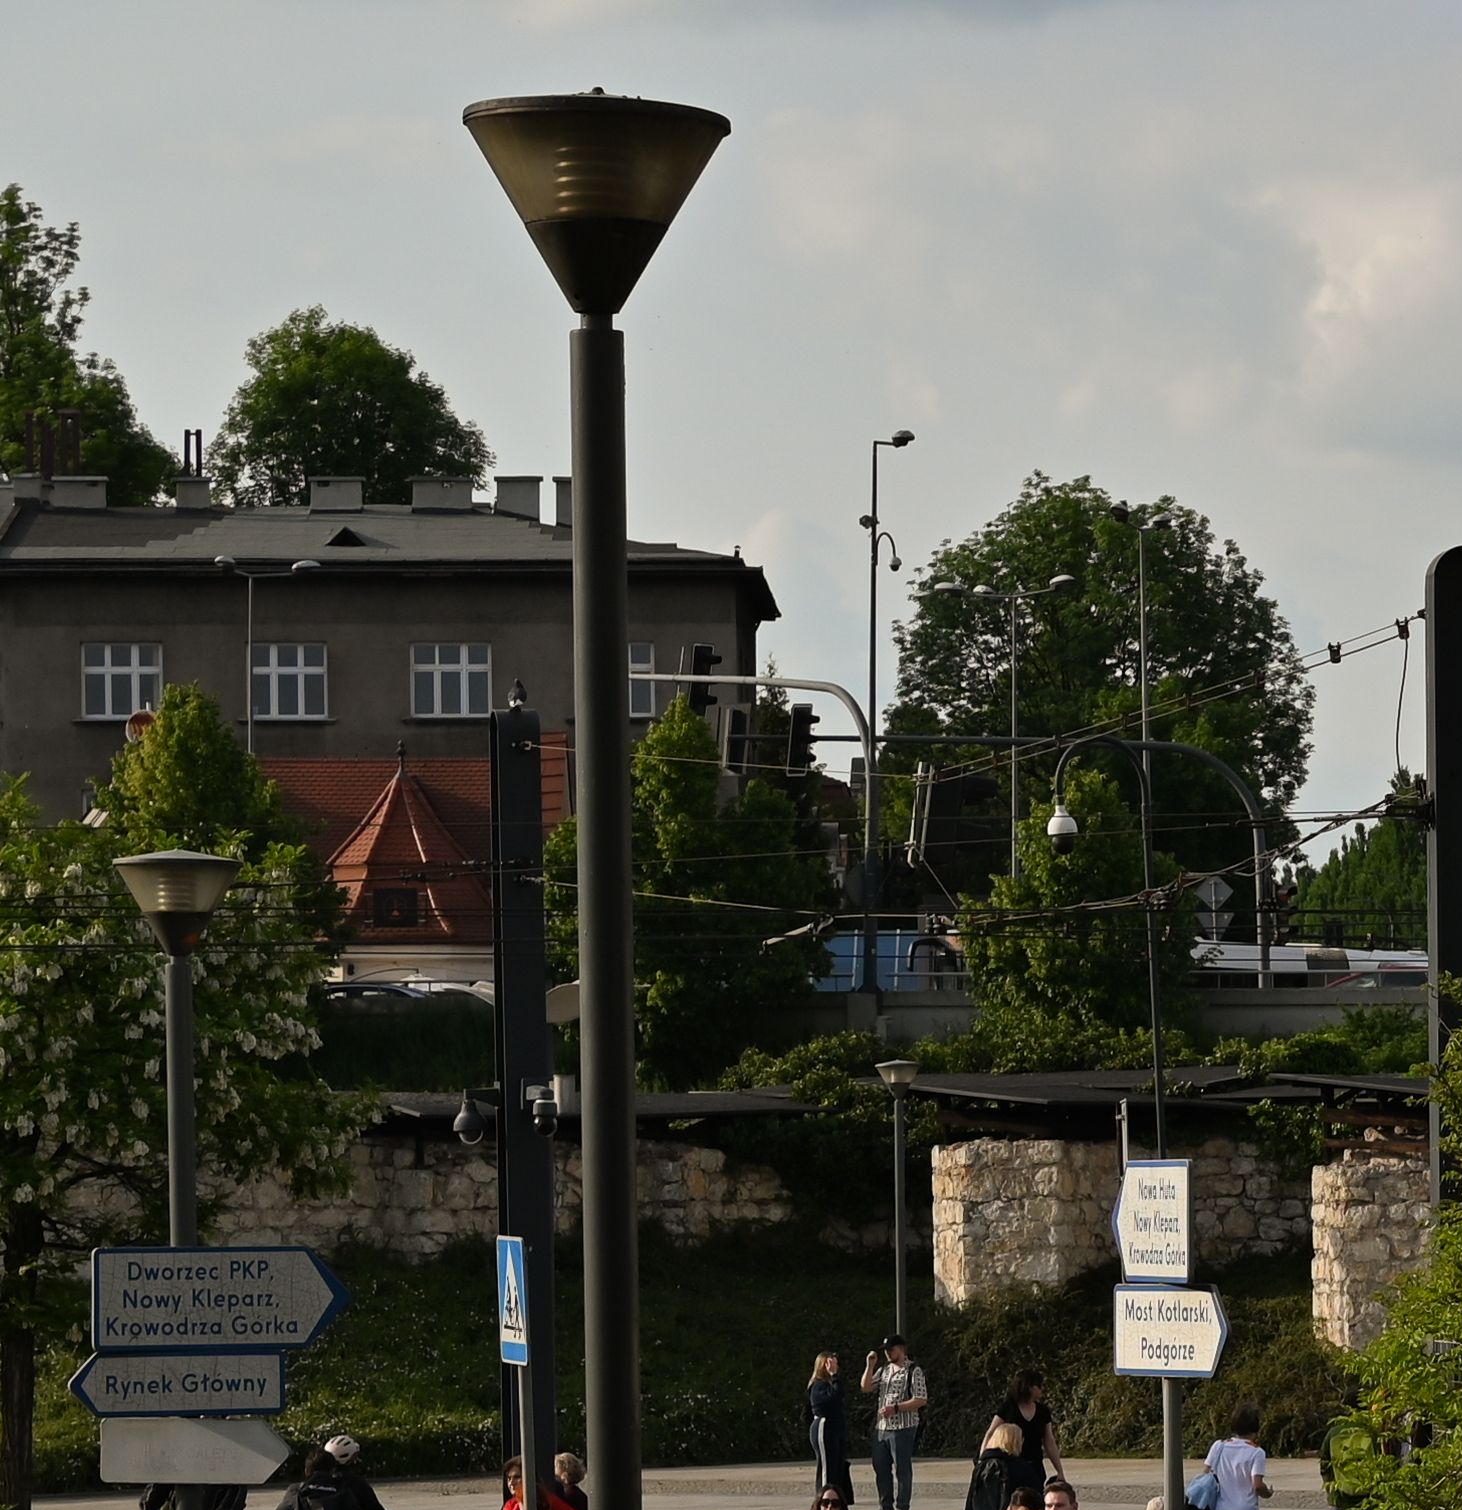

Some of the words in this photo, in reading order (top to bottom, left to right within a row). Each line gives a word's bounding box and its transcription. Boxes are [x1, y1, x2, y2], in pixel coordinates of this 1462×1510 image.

[1138, 1178, 1157, 1200] Nowa
[1159, 1178, 1176, 1200] Huta
[1133, 1210, 1152, 1238] Nowy
[1153, 1210, 1181, 1240] Kleparz,
[1128, 1242, 1163, 1265] Krowodrza
[1165, 1242, 1186, 1266] Górka
[127, 1261, 219, 1281] Dworzec
[229, 1259, 275, 1282] PKP,
[123, 1289, 182, 1313] Nowy
[192, 1288, 280, 1312] Kleparz,
[1125, 1298, 1153, 1321] Most
[1157, 1298, 1212, 1325] Kotlarski,
[106, 1316, 223, 1337] Krowodrza
[231, 1314, 299, 1335] Górka
[1141, 1337, 1195, 1366] Podgórze
[105, 1375, 173, 1400] Rynek
[182, 1373, 267, 1397] Główny
